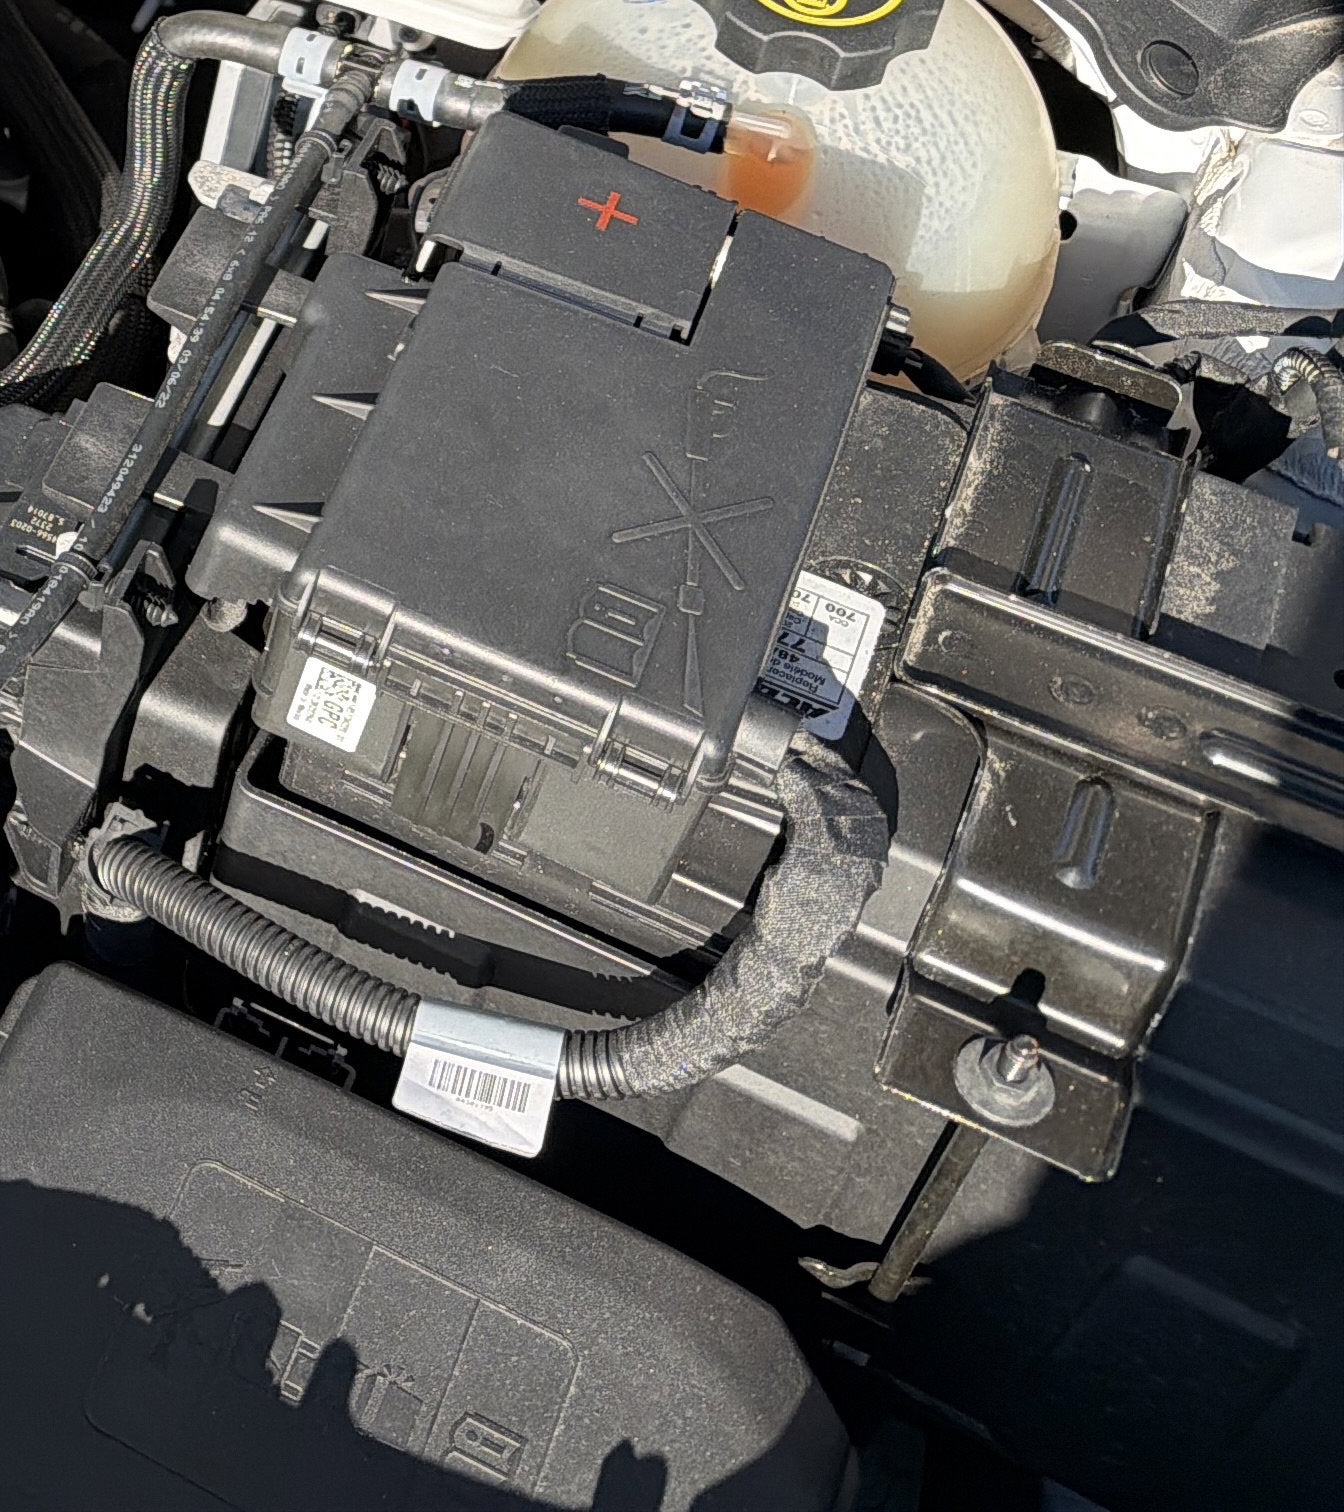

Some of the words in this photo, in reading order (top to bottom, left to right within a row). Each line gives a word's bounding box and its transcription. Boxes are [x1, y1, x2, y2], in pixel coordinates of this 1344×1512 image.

[29, 515, 53, 531] 2372
[823, 601, 857, 622] 700
[317, 700, 344, 729] GPC
